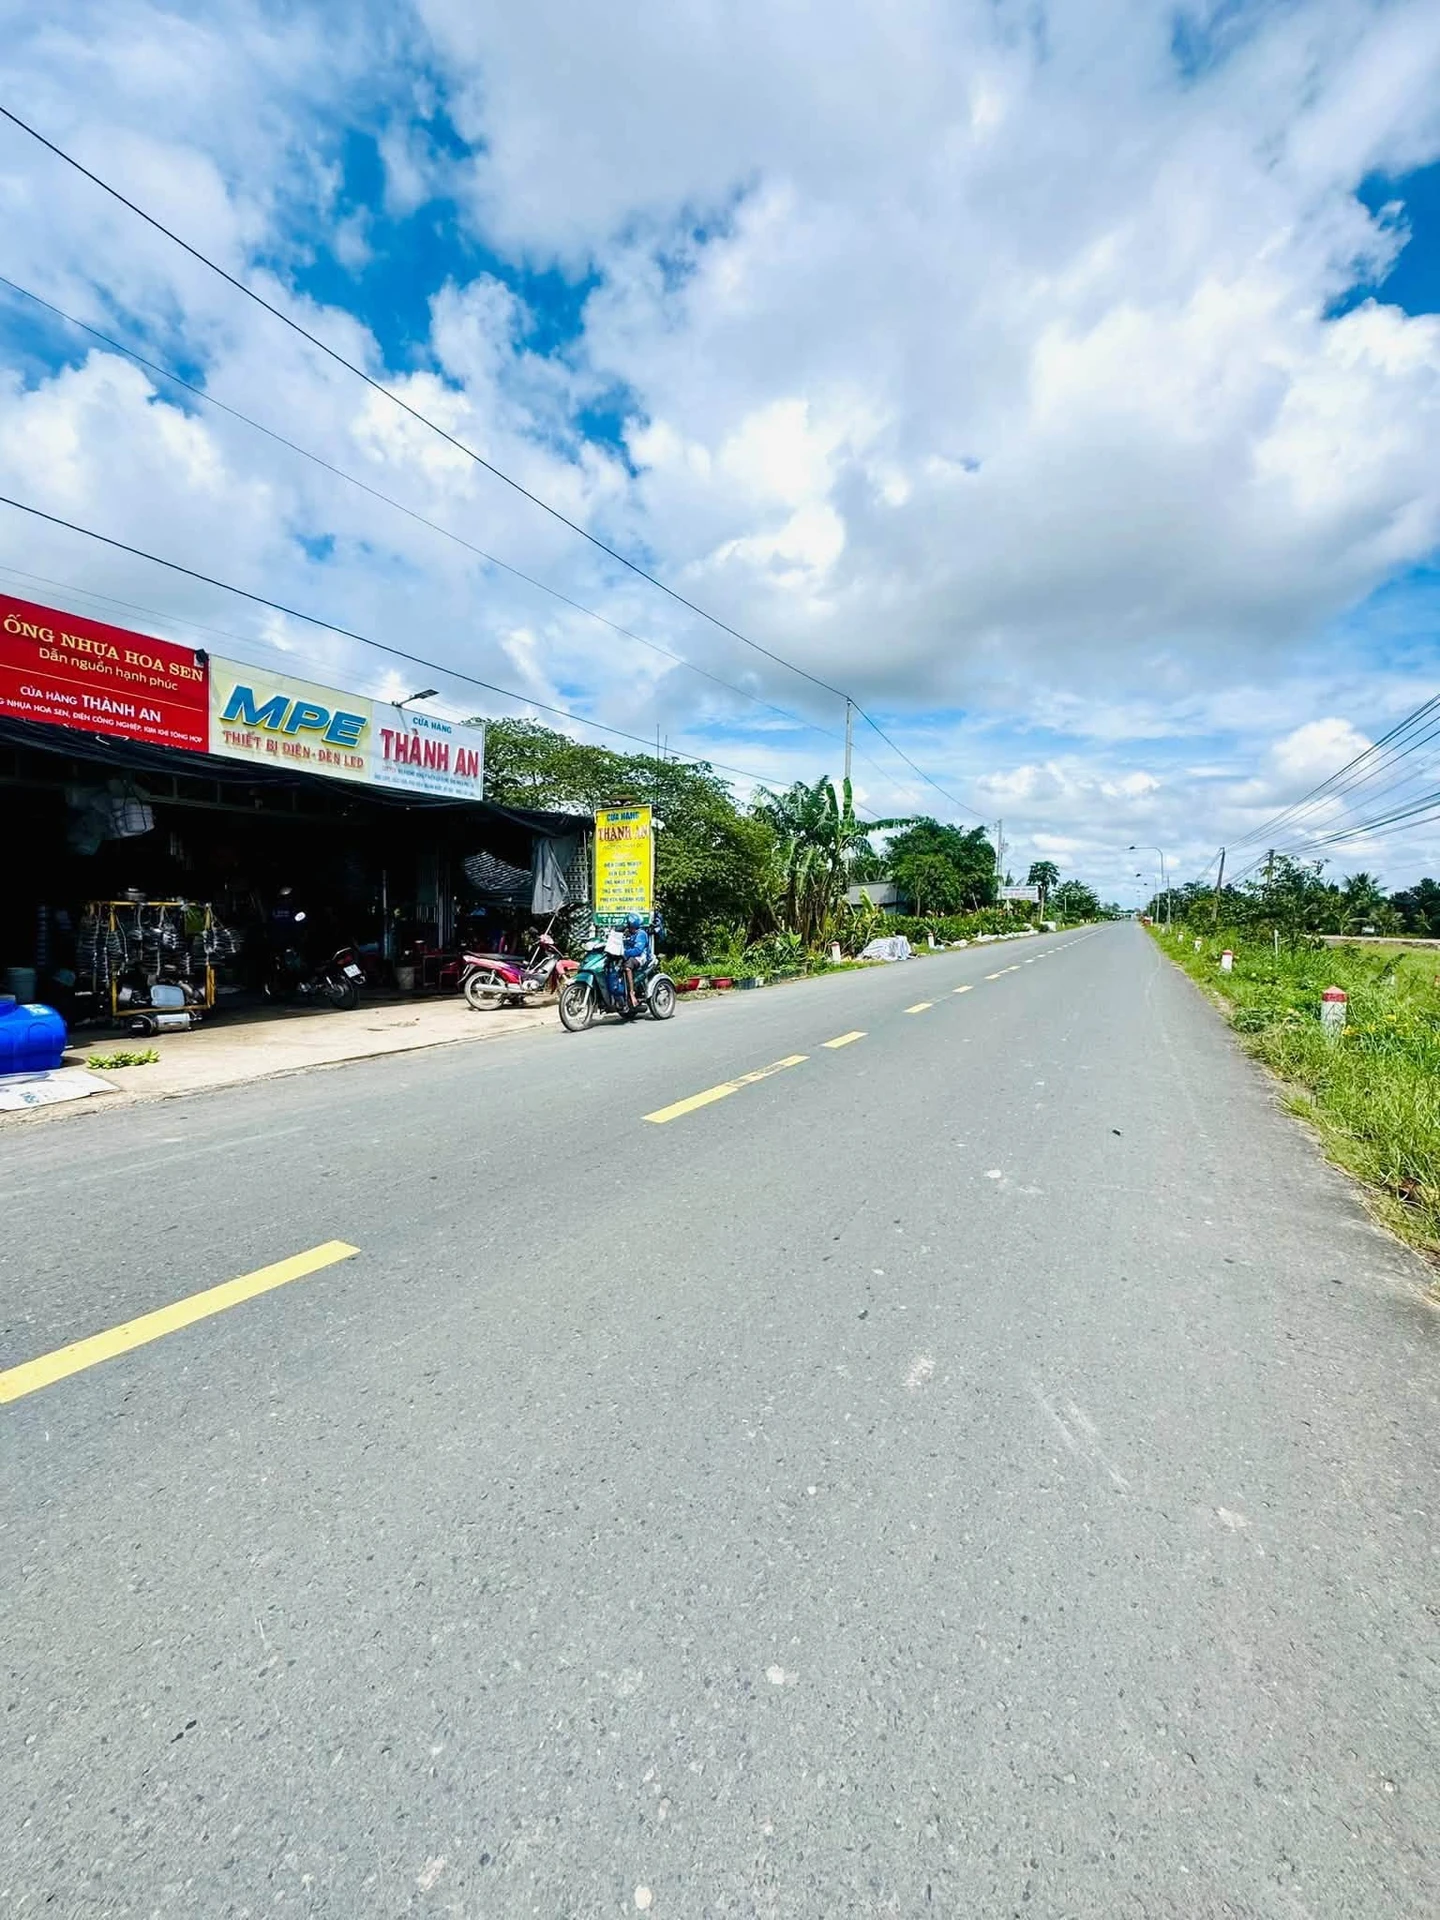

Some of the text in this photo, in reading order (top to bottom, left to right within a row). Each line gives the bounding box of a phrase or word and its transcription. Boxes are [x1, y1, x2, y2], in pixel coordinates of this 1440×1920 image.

[3, 614, 203, 682] ỐNG NHỰA HOA SEN
[39, 647, 178, 690] Dẫn nguồn hạnh phúc
[33, 703, 52, 714] HOA
[92, 714, 114, 726] CÔNG
[45, 691, 78, 705] HÀNG
[81, 694, 135, 717] THÀNH
[139, 707, 162, 723] AN
[219, 683, 367, 748] MPE
[431, 721, 452, 734] HÀNG
[222, 729, 261, 749] THIẾT
[265, 739, 279, 756] BỊ
[343, 754, 365, 769] LED
[379, 728, 449, 772] THÀNH
[453, 747, 479, 778] AN
